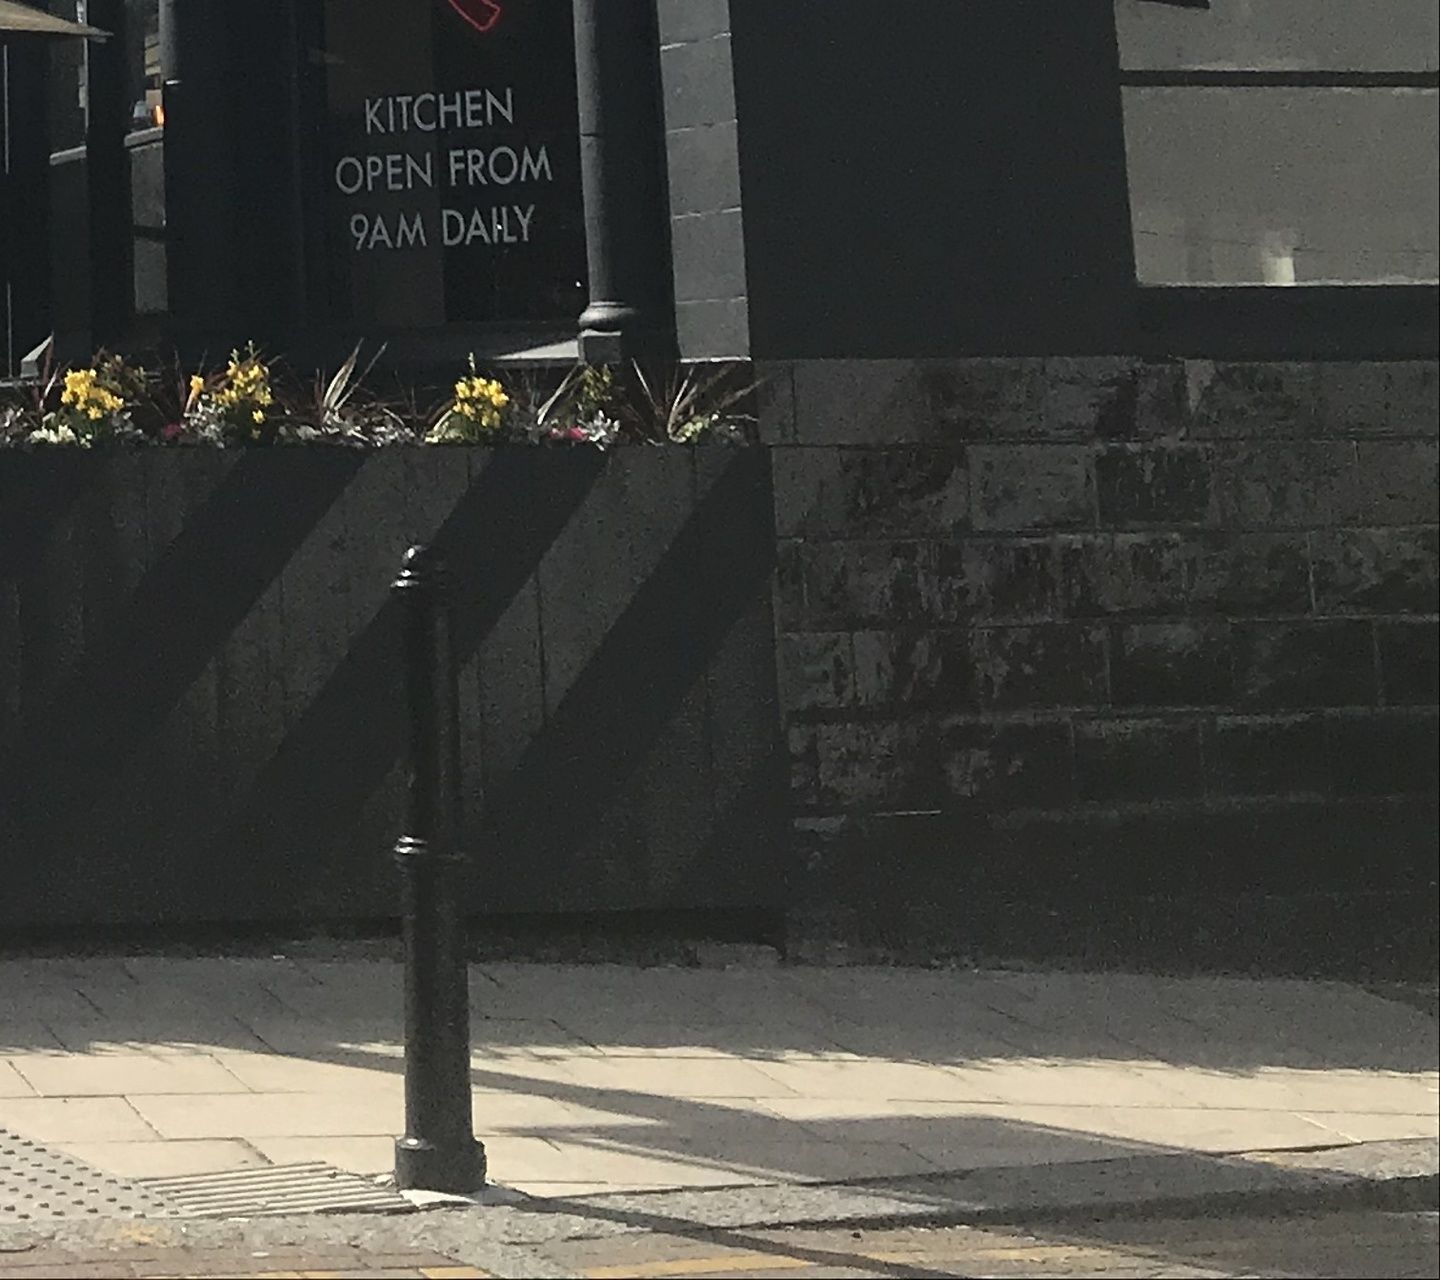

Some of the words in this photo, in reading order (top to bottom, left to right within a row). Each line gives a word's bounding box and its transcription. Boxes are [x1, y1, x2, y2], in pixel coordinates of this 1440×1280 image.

[364, 88, 514, 135] KITCHEN
[335, 152, 433, 195] OPEN
[449, 145, 553, 187] FROM
[350, 211, 428, 251] 9AM
[441, 204, 536, 247] DAILY
